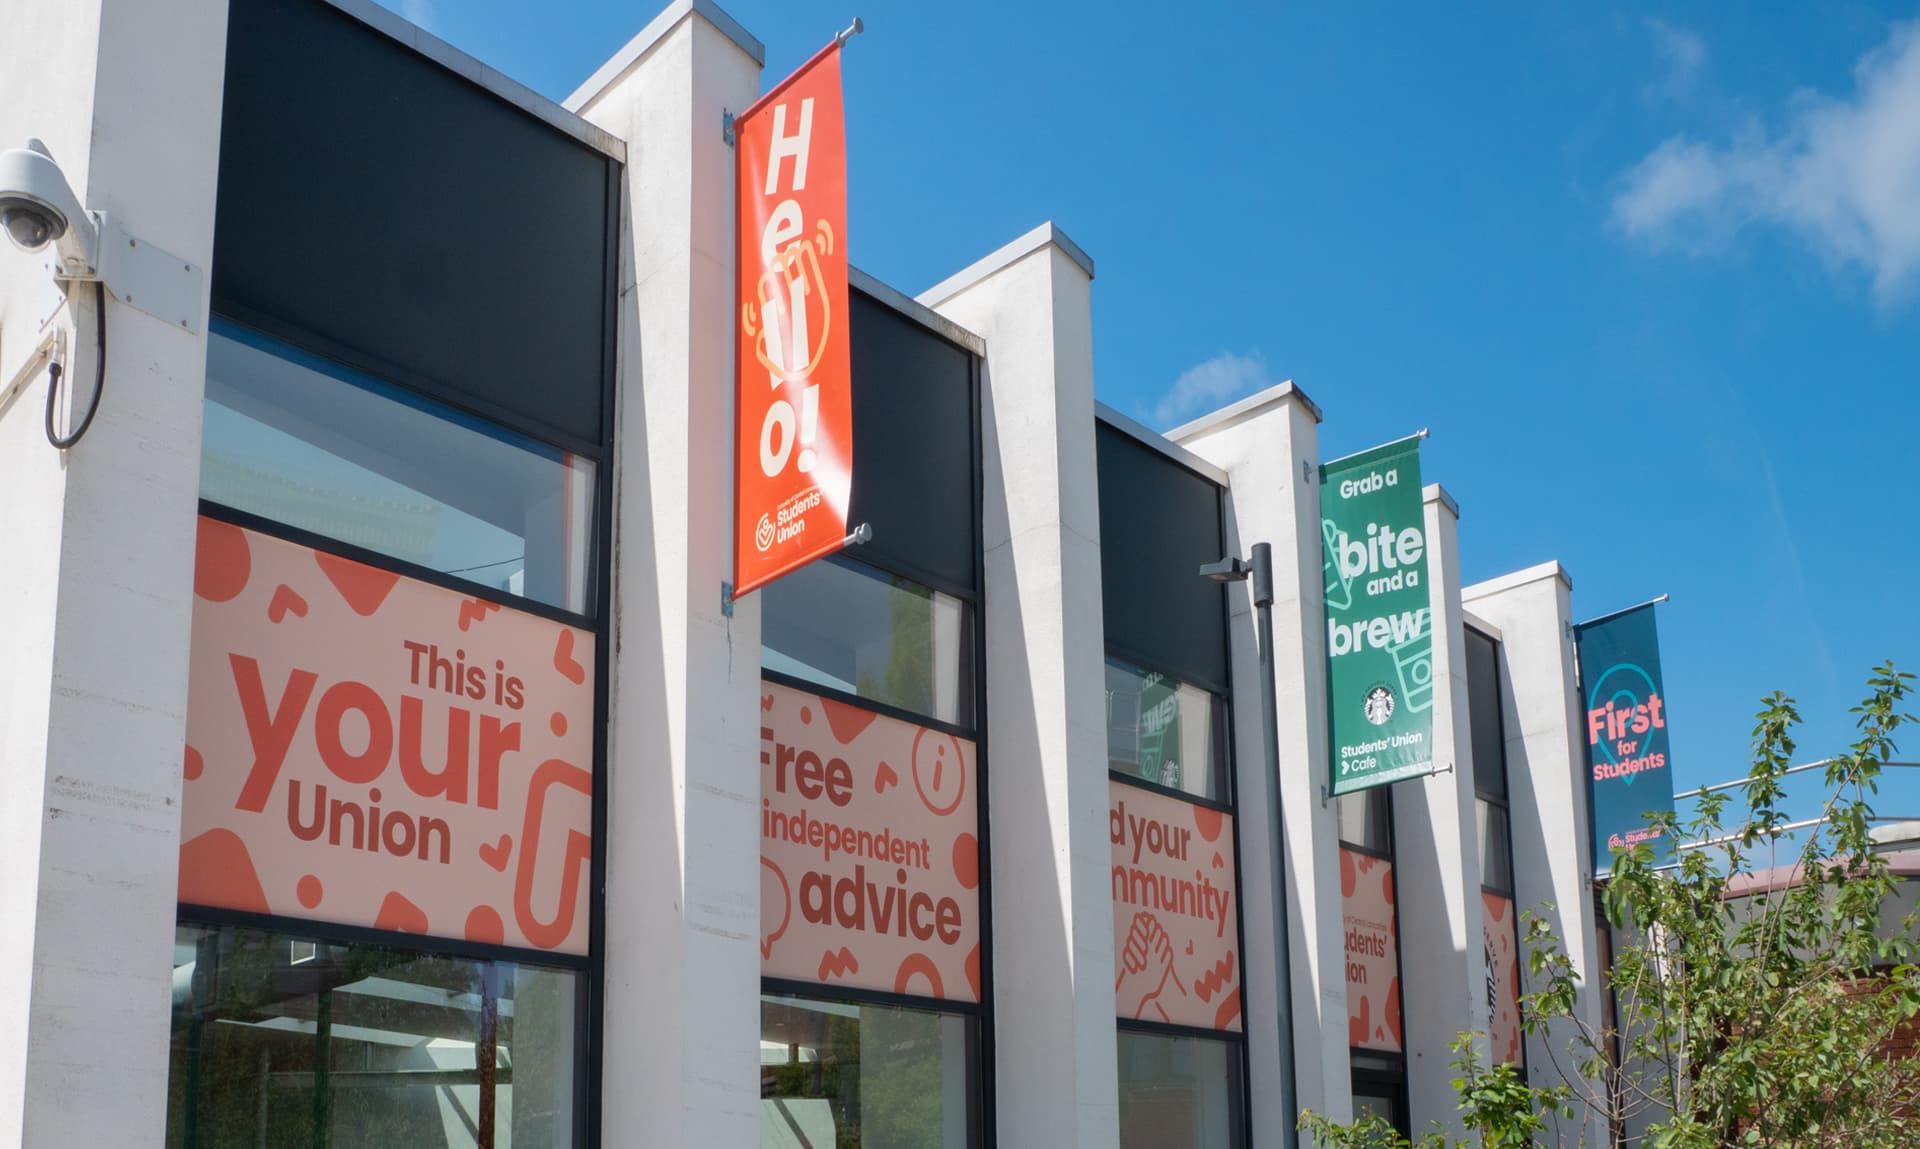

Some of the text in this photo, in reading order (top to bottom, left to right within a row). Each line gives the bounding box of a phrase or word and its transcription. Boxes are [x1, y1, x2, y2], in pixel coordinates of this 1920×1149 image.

[1340, 469, 1398, 499] Grab a
[777, 518, 805, 544] Union
[1339, 523, 1423, 579] bite
[1367, 570, 1418, 595] and a
[1328, 608, 1425, 657] brew
[404, 640, 524, 710] This is
[228, 653, 521, 813] your
[1588, 694, 1664, 744] First
[1341, 732, 1423, 758] Students' Union
[1351, 756, 1376, 771] Cafe
[1593, 752, 1665, 781] Students
[1617, 740, 1637, 756] for
[288, 779, 451, 864] Union
[763, 798, 931, 869] independent
[1128, 814, 1191, 864] your
[799, 865, 962, 945] advice
